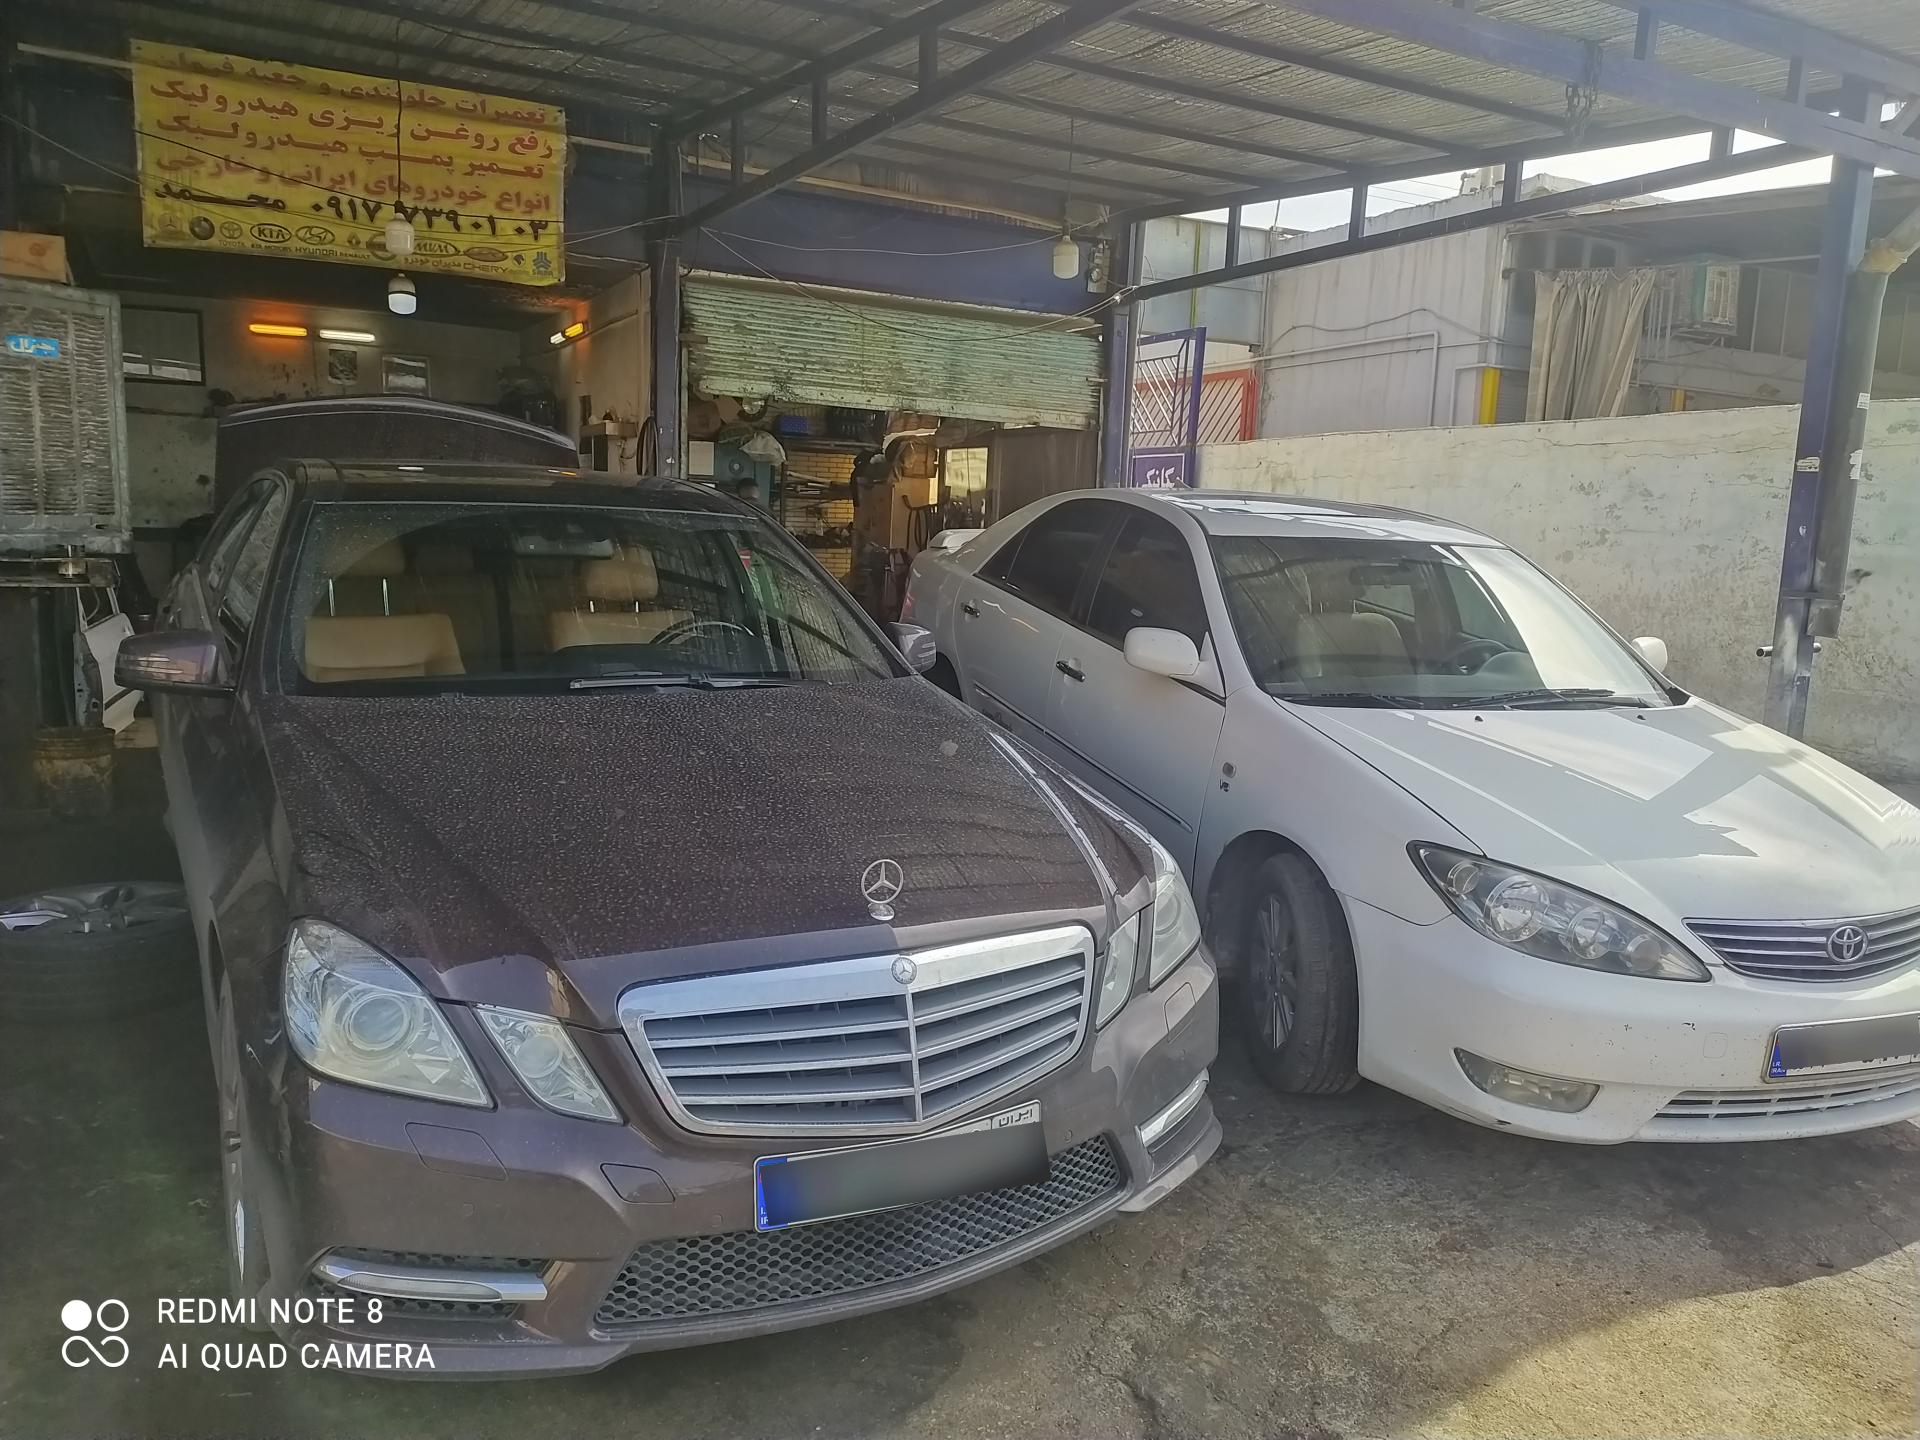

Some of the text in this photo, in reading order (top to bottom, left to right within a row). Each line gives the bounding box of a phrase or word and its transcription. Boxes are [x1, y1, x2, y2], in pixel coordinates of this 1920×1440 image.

[150, 80, 553, 159] رفع روغن ریزی هیدرولیک
[157, 115, 544, 180] تعمیر پمپ هیدرولیک
[279, 164, 357, 191] ایرانی
[364, 174, 487, 206] خودروهای
[155, 183, 287, 211] محمد
[495, 188, 550, 212] انواع
[999, 1108, 1033, 1128] ایران
